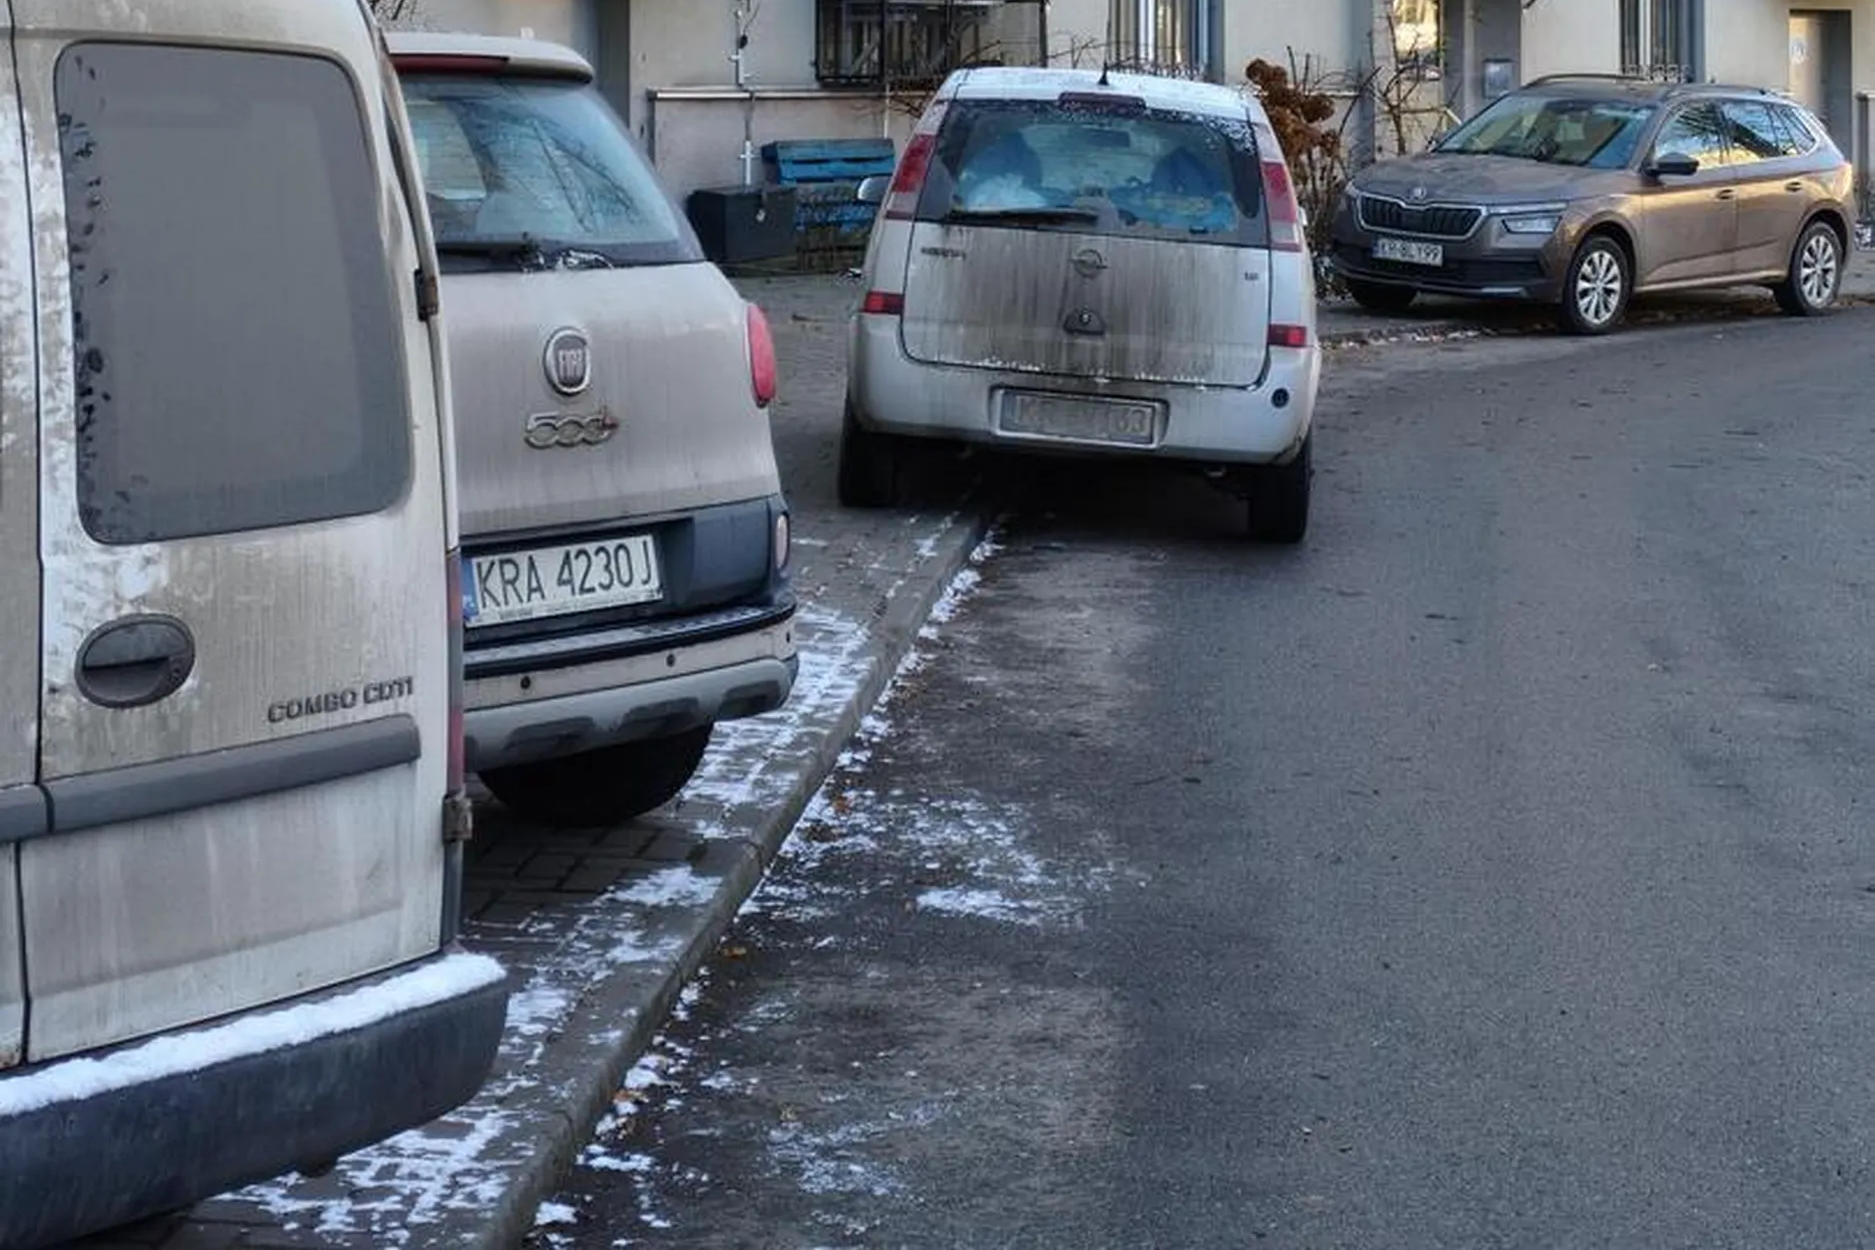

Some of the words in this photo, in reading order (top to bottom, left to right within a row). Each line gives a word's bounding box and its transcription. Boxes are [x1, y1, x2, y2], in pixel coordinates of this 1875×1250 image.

[476, 555, 546, 609] KRA
[557, 539, 652, 596] 4230J
[267, 687, 358, 723] COMBO
